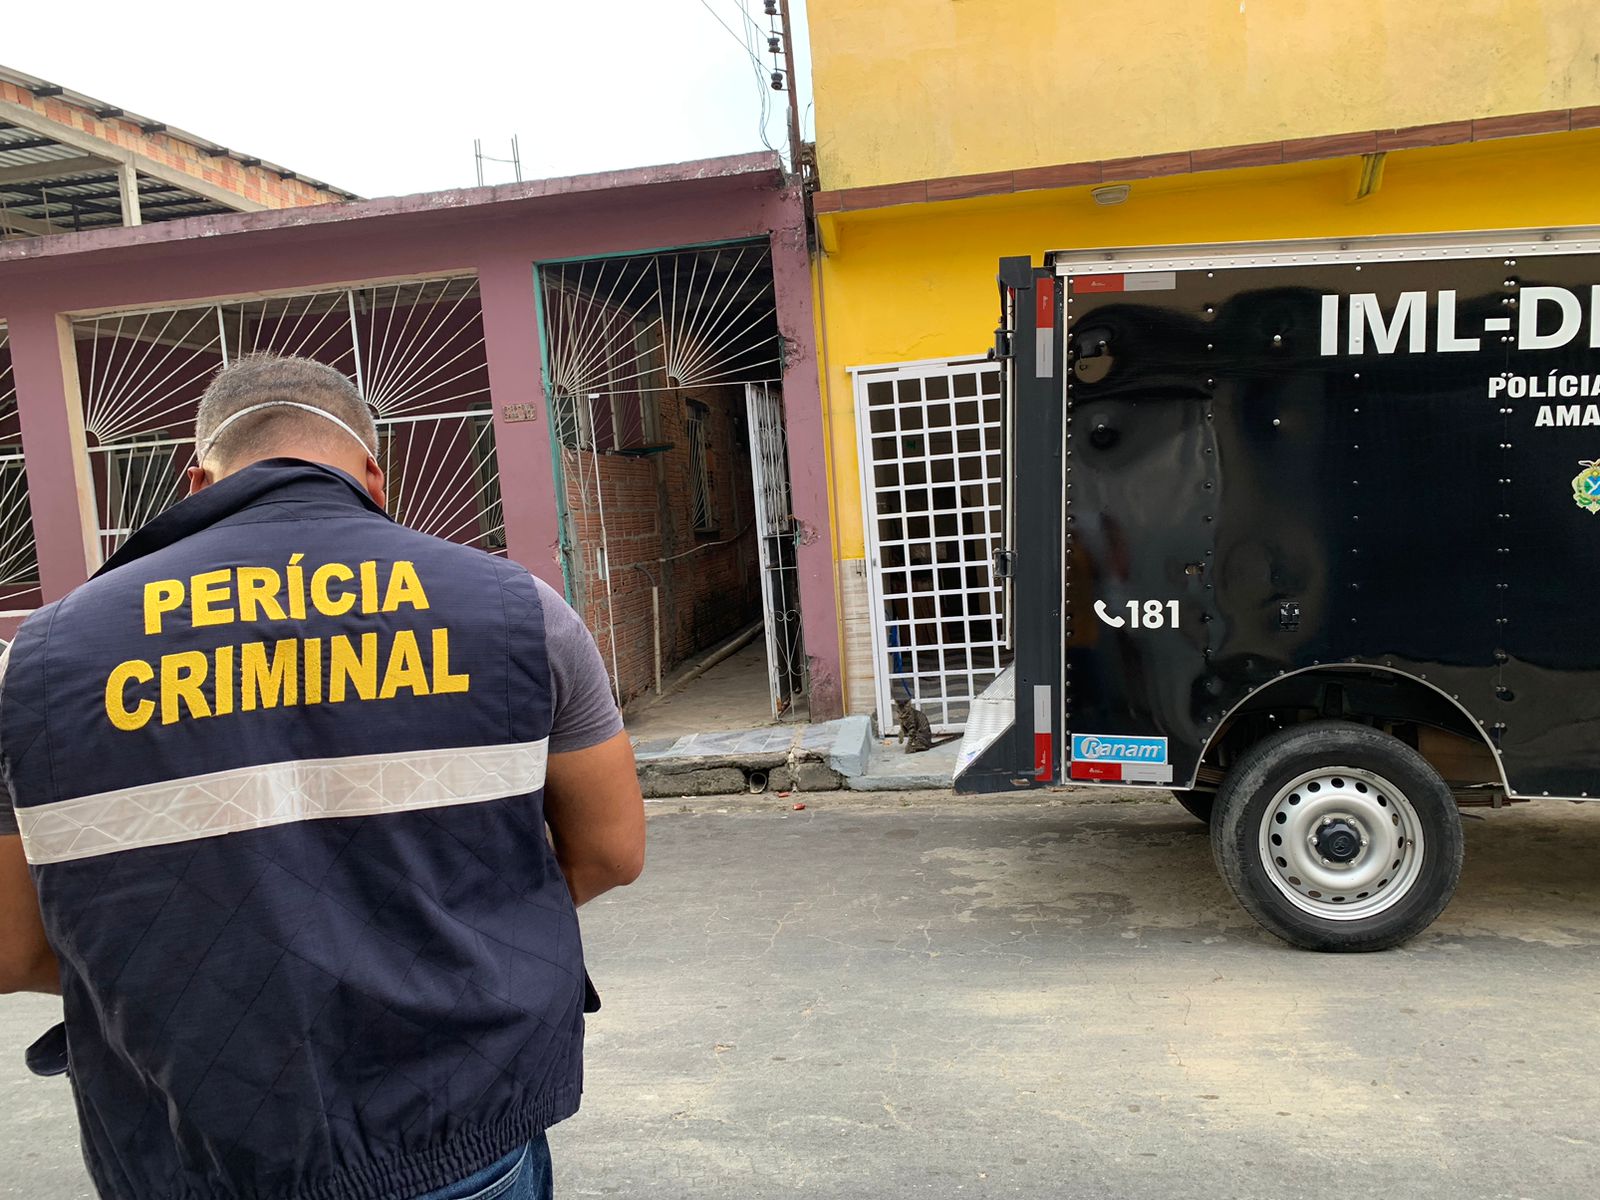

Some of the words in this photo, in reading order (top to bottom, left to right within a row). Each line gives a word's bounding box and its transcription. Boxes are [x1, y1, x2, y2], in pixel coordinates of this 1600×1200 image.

[1534, 404, 1600, 427] AMA
[143, 553, 430, 635] PERÍCIA
[1125, 599, 1180, 629] 181
[105, 627, 470, 731] CRIMINAL
[1081, 737, 1161, 758] Ranam
